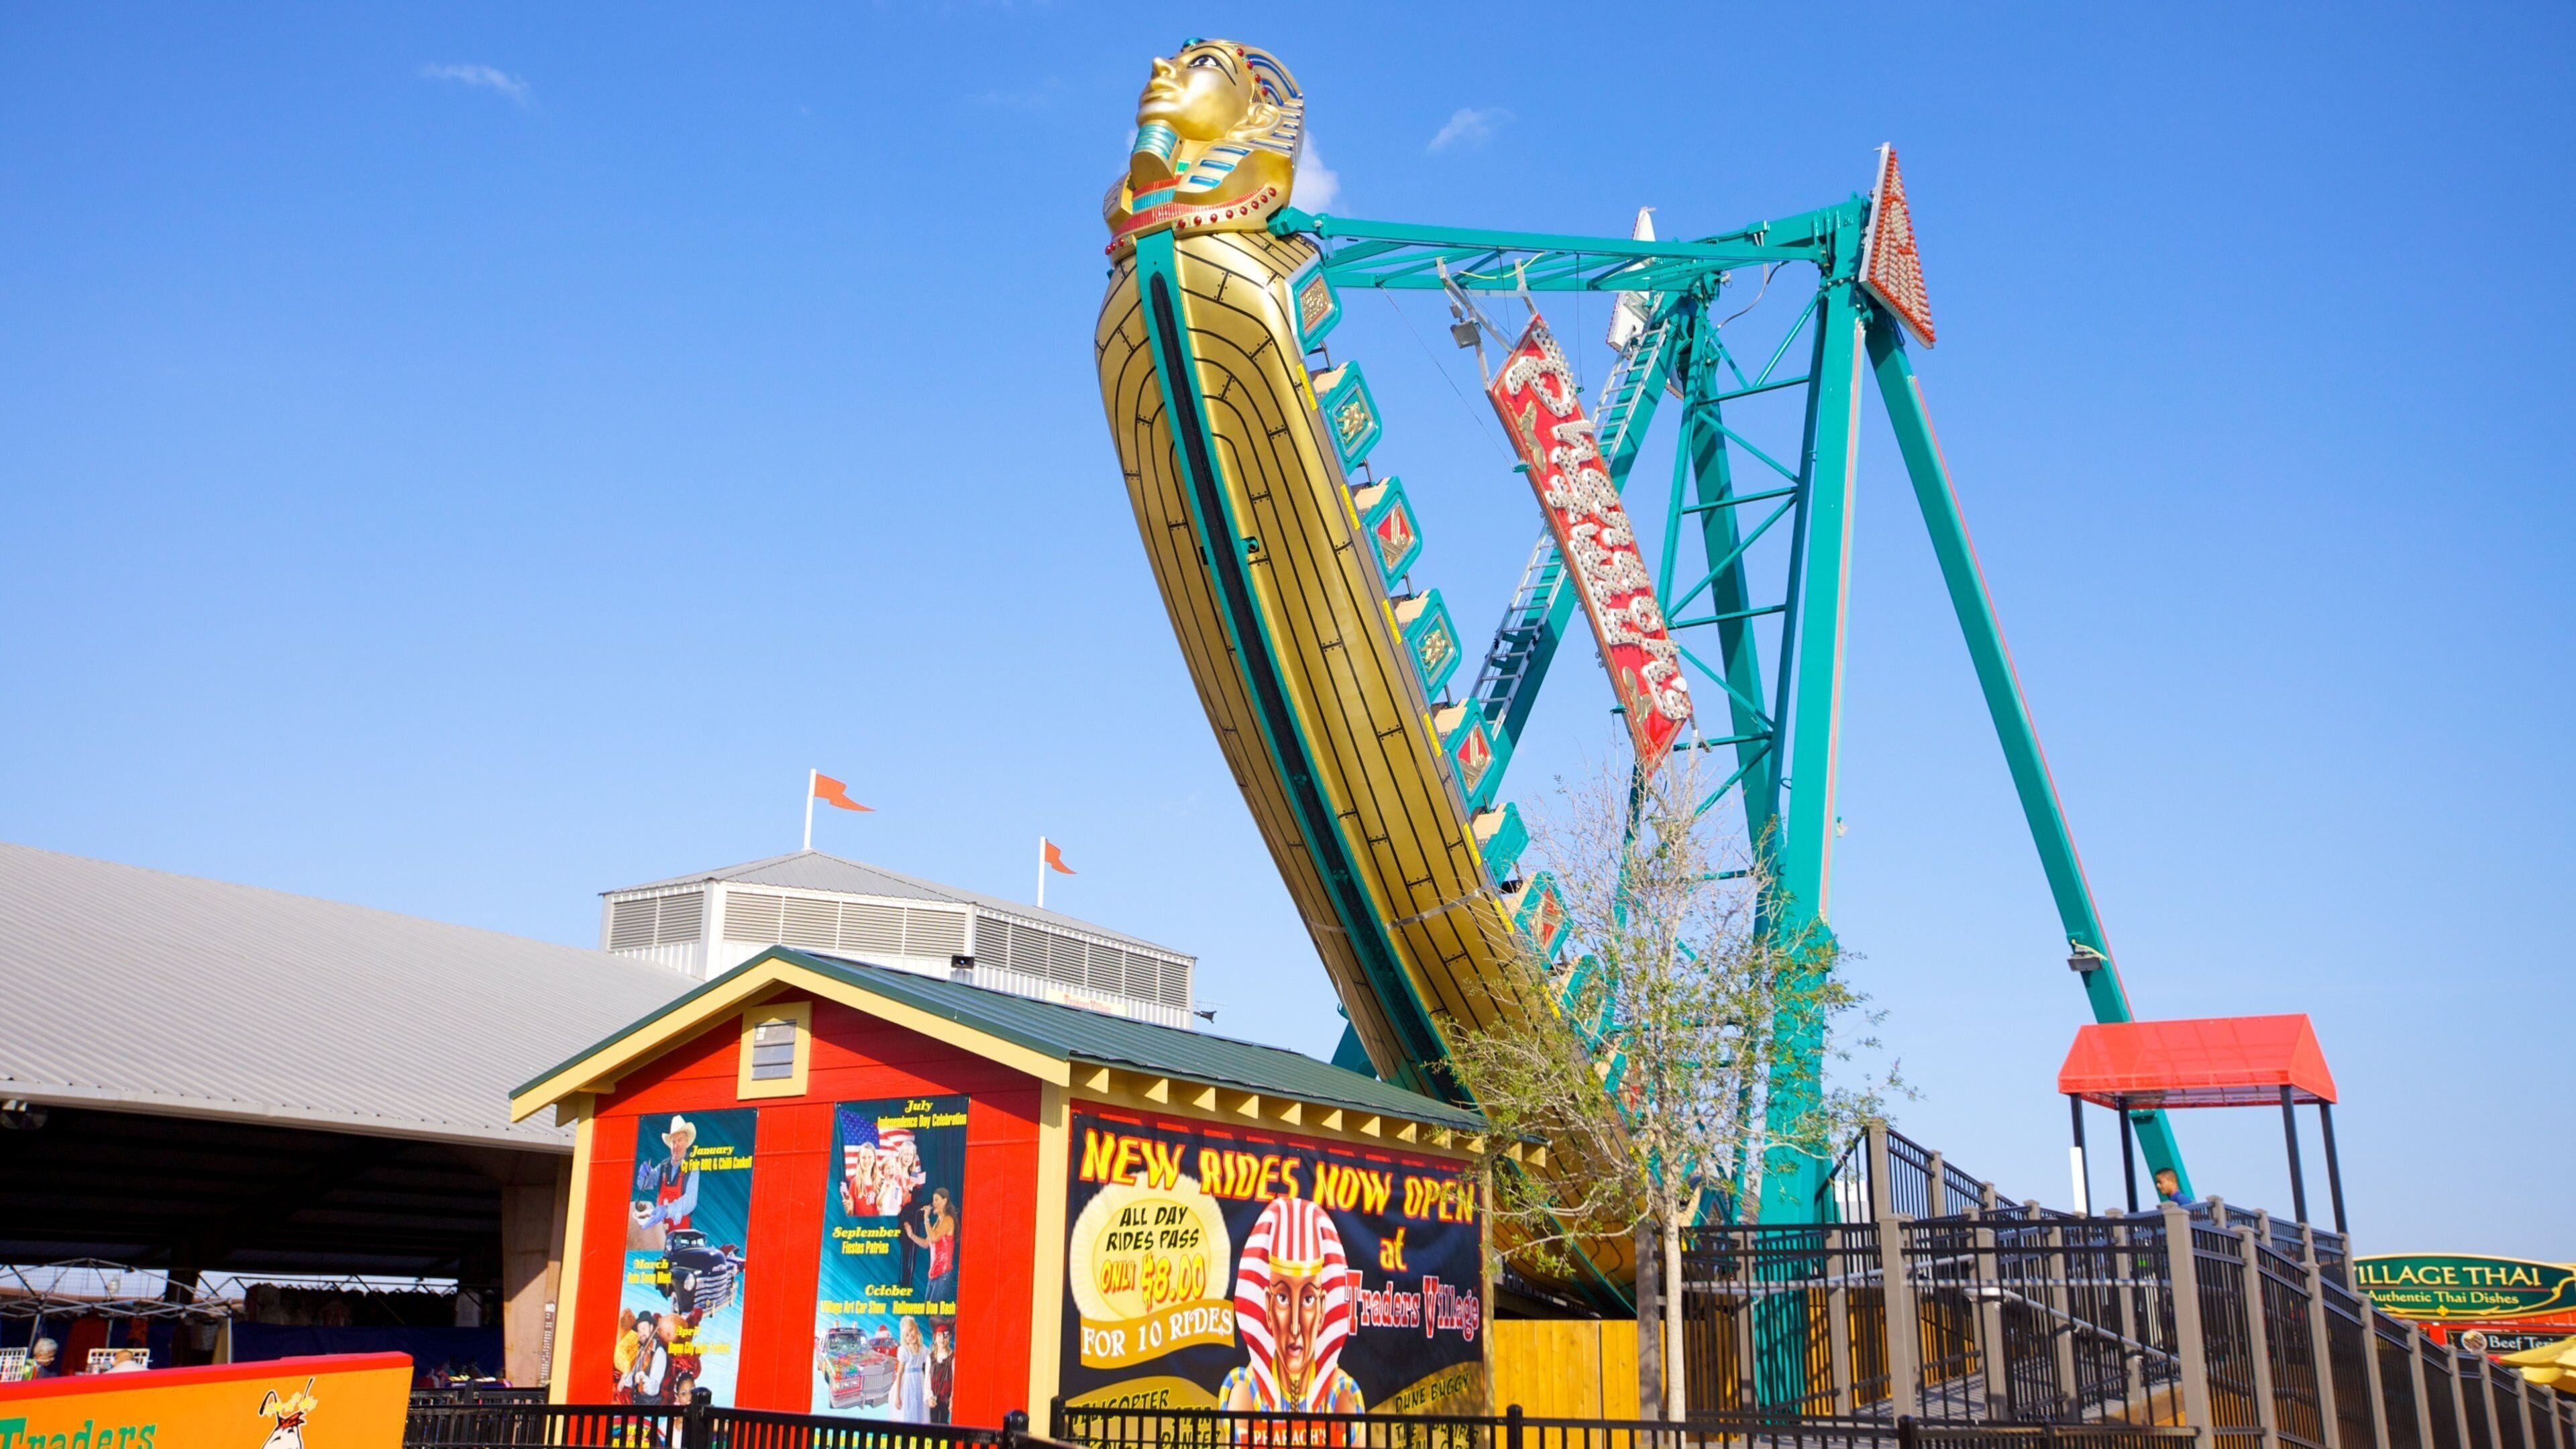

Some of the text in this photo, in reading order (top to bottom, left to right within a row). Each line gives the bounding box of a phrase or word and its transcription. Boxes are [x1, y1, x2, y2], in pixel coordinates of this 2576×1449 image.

[904, 1099, 933, 1113] July
[877, 1112, 967, 1129] Independence Day Celebration
[690, 1146, 735, 1157] January
[712, 1157, 718, 1171] &
[1079, 1128, 1474, 1224] NEW RIDES NOW OPEN
[1119, 1206, 1188, 1228] ALL DAY
[832, 1226, 902, 1240] September
[1106, 1228, 1199, 1252] RIDES PASS
[1379, 1226, 1407, 1272] at
[633, 1258, 669, 1269] March
[1101, 1250, 1206, 1313] ONLY $8.00
[2353, 1265, 2542, 1286] ILLAGE THAI
[865, 1284, 913, 1296] October
[2368, 1289, 2520, 1304] Authentic Thai Dishes
[892, 1300, 956, 1315] Halloween Boo Bash
[1345, 1269, 1479, 1342] Traders Village
[676, 1325, 701, 1338] April
[1082, 1307, 1234, 1358] FOR 10 RIDES
[2489, 1335, 2522, 1351] Beef
[1395, 1372, 1470, 1413] DUNE BUGGY
[1161, 1430, 1221, 1449] DNER
